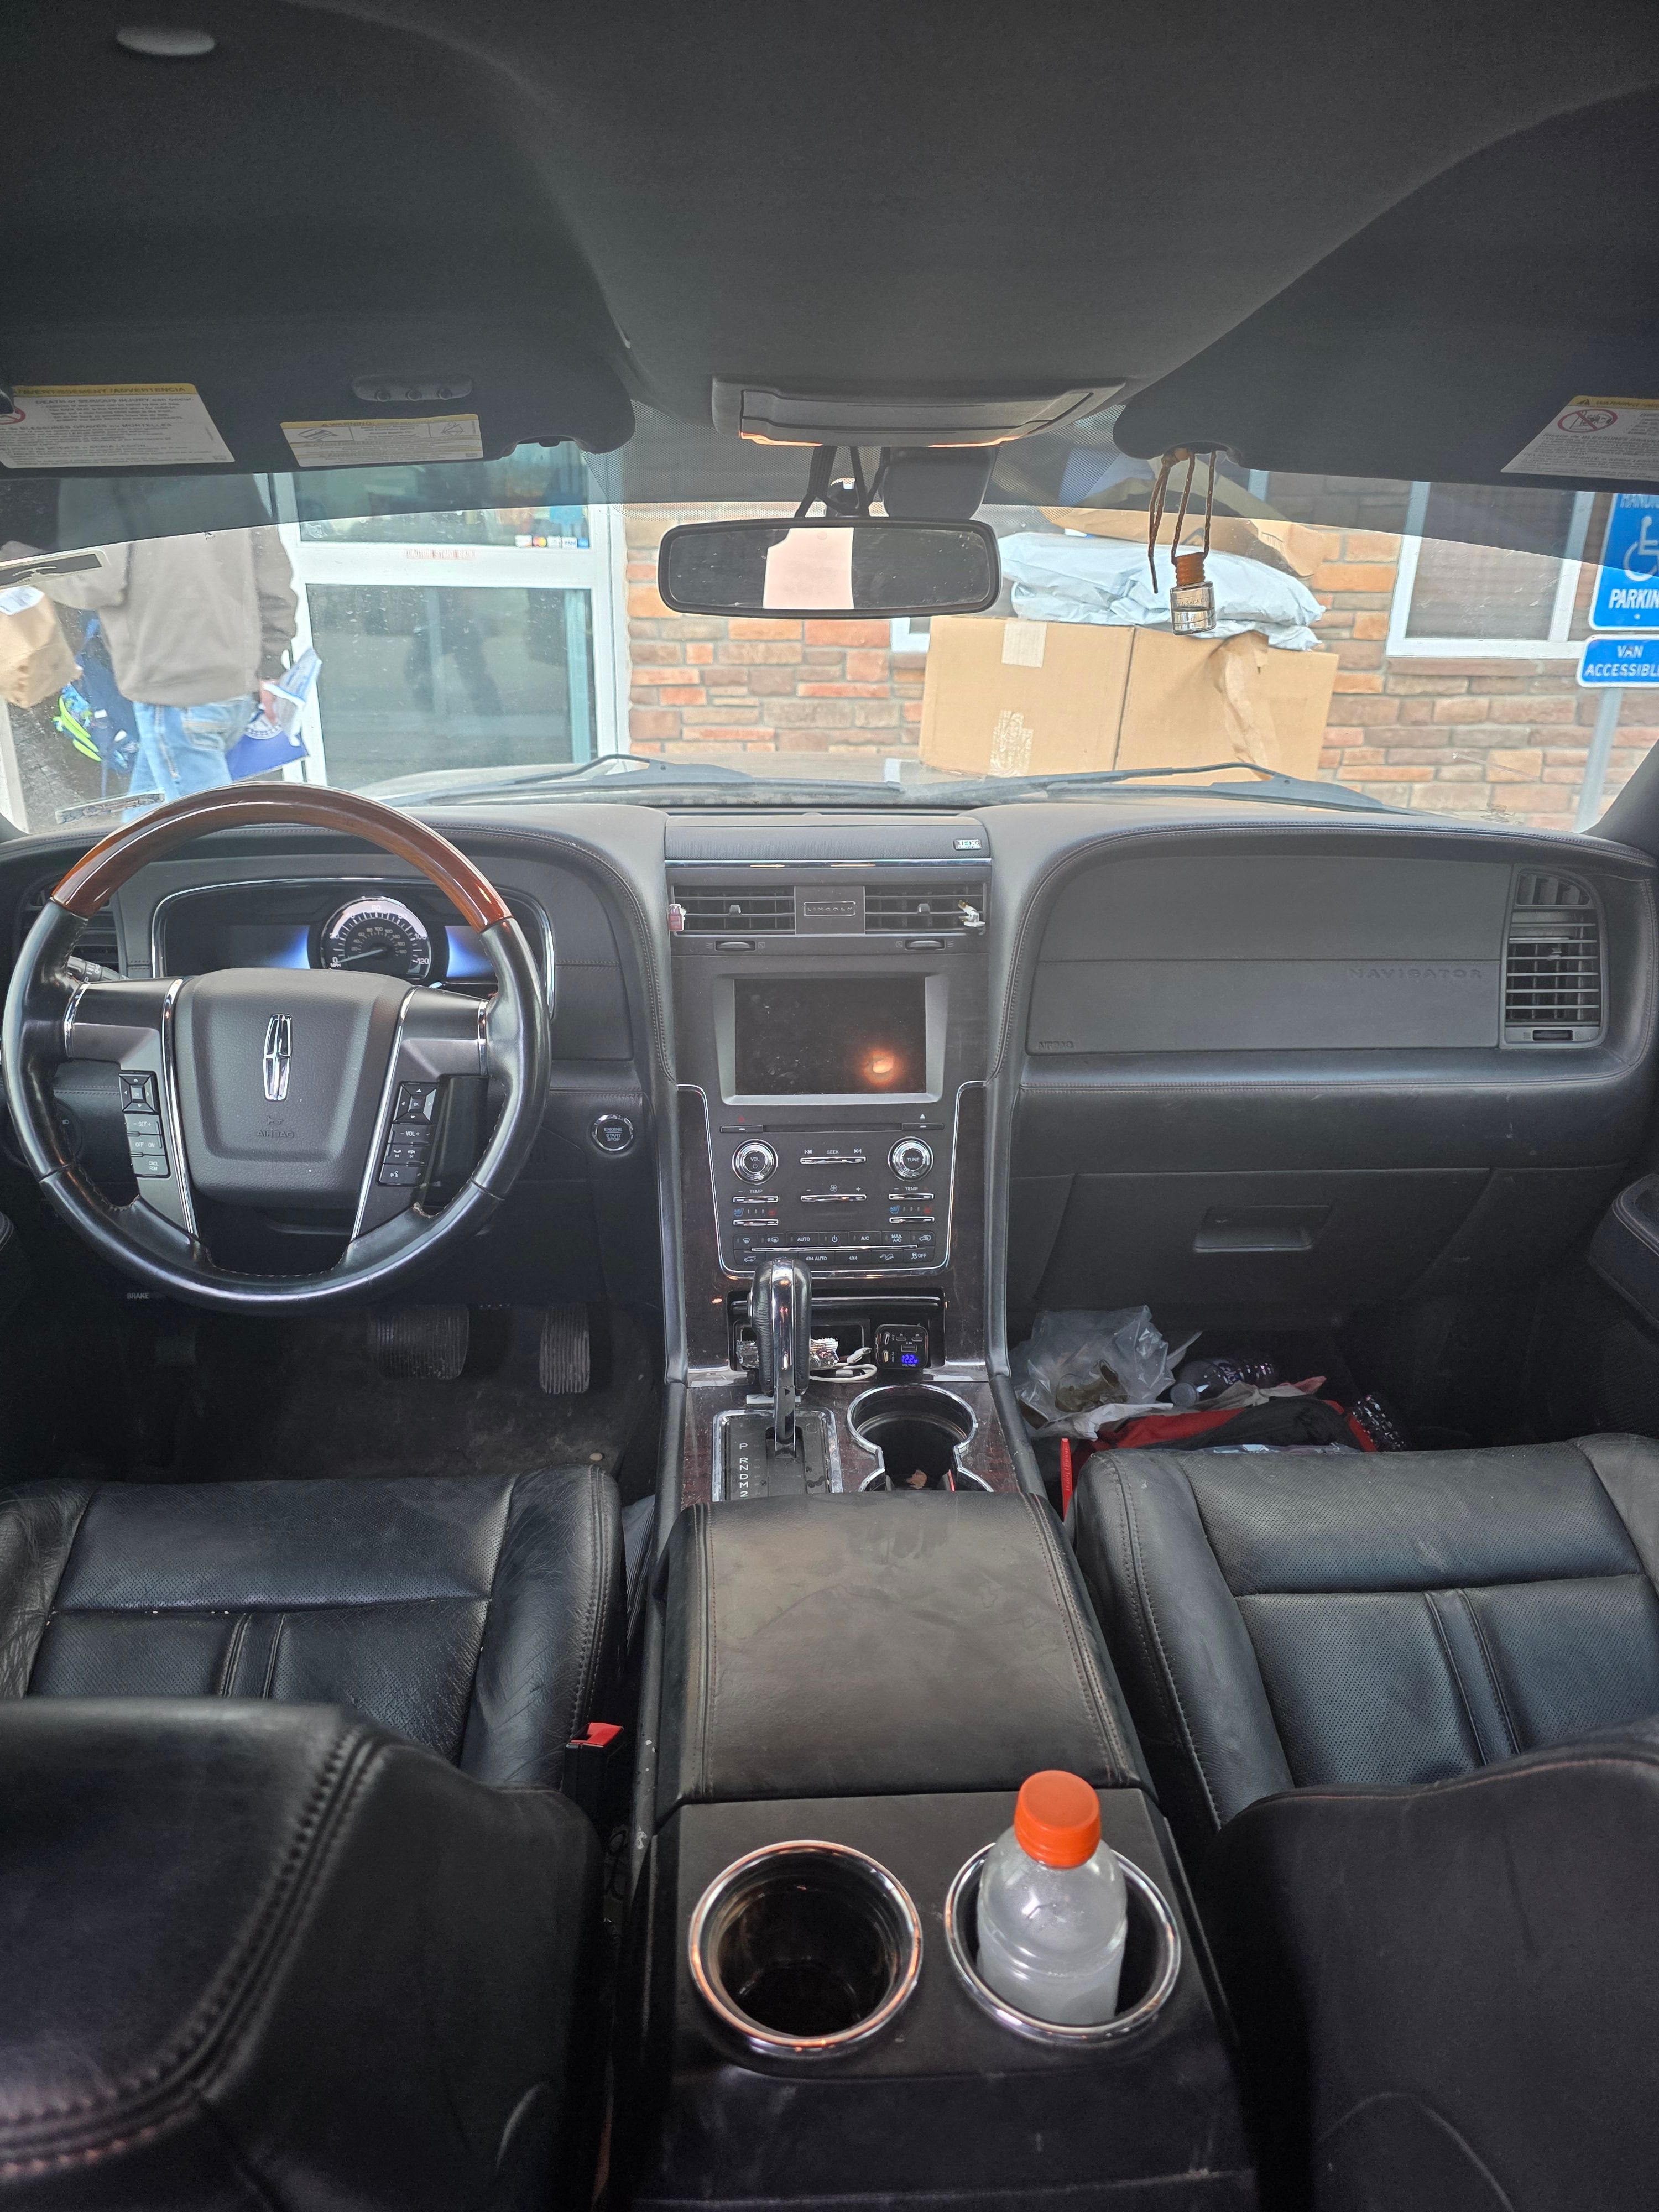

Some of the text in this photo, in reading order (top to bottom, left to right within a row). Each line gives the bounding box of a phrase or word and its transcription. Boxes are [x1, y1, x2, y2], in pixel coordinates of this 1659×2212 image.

[1617, 645, 1644, 658] VAN
[1584, 663, 1659, 677] ACCESSIBL
[1348, 968, 1483, 979] NAVIGATOR
[257, 1130, 295, 1138] AIRBAG
